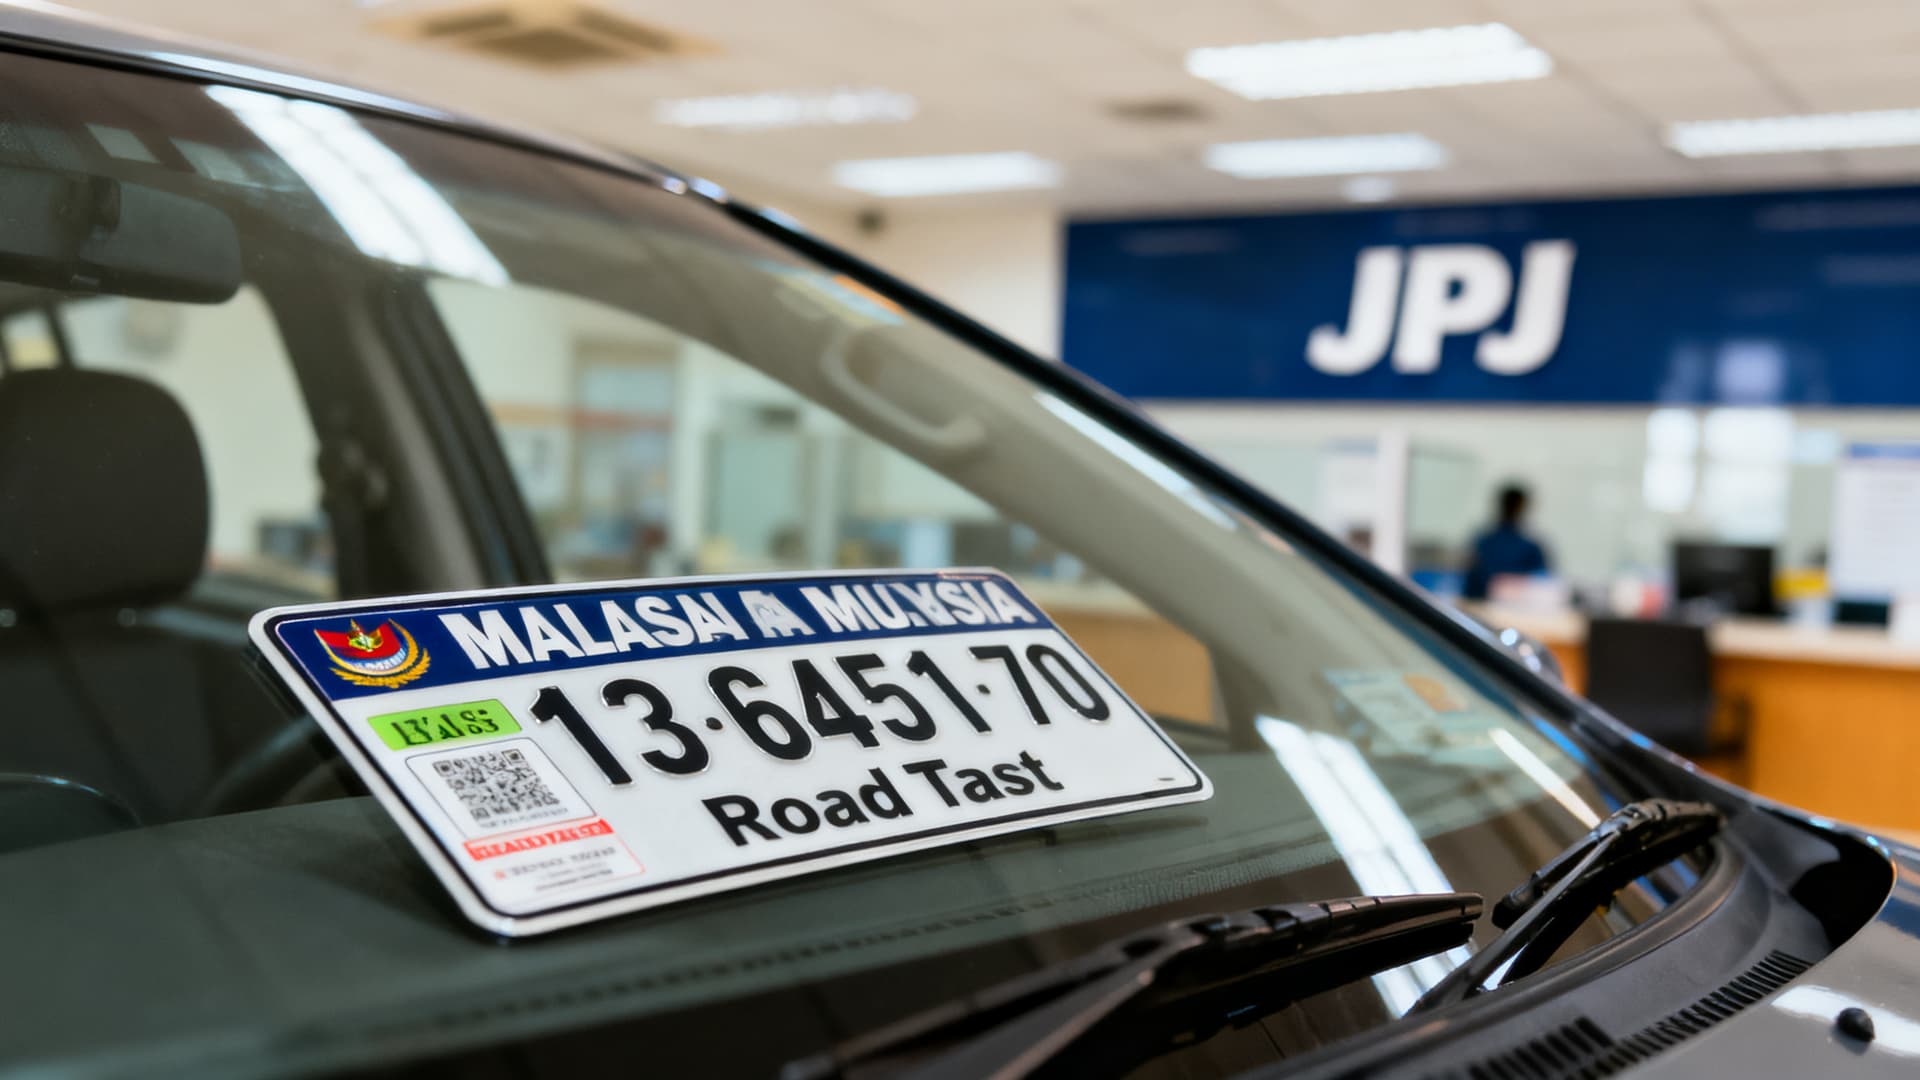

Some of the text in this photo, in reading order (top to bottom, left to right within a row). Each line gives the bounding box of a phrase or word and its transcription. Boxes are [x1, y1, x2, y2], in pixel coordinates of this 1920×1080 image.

[1306, 241, 1576, 375] JPJ
[702, 751, 1064, 847] Road Tast
